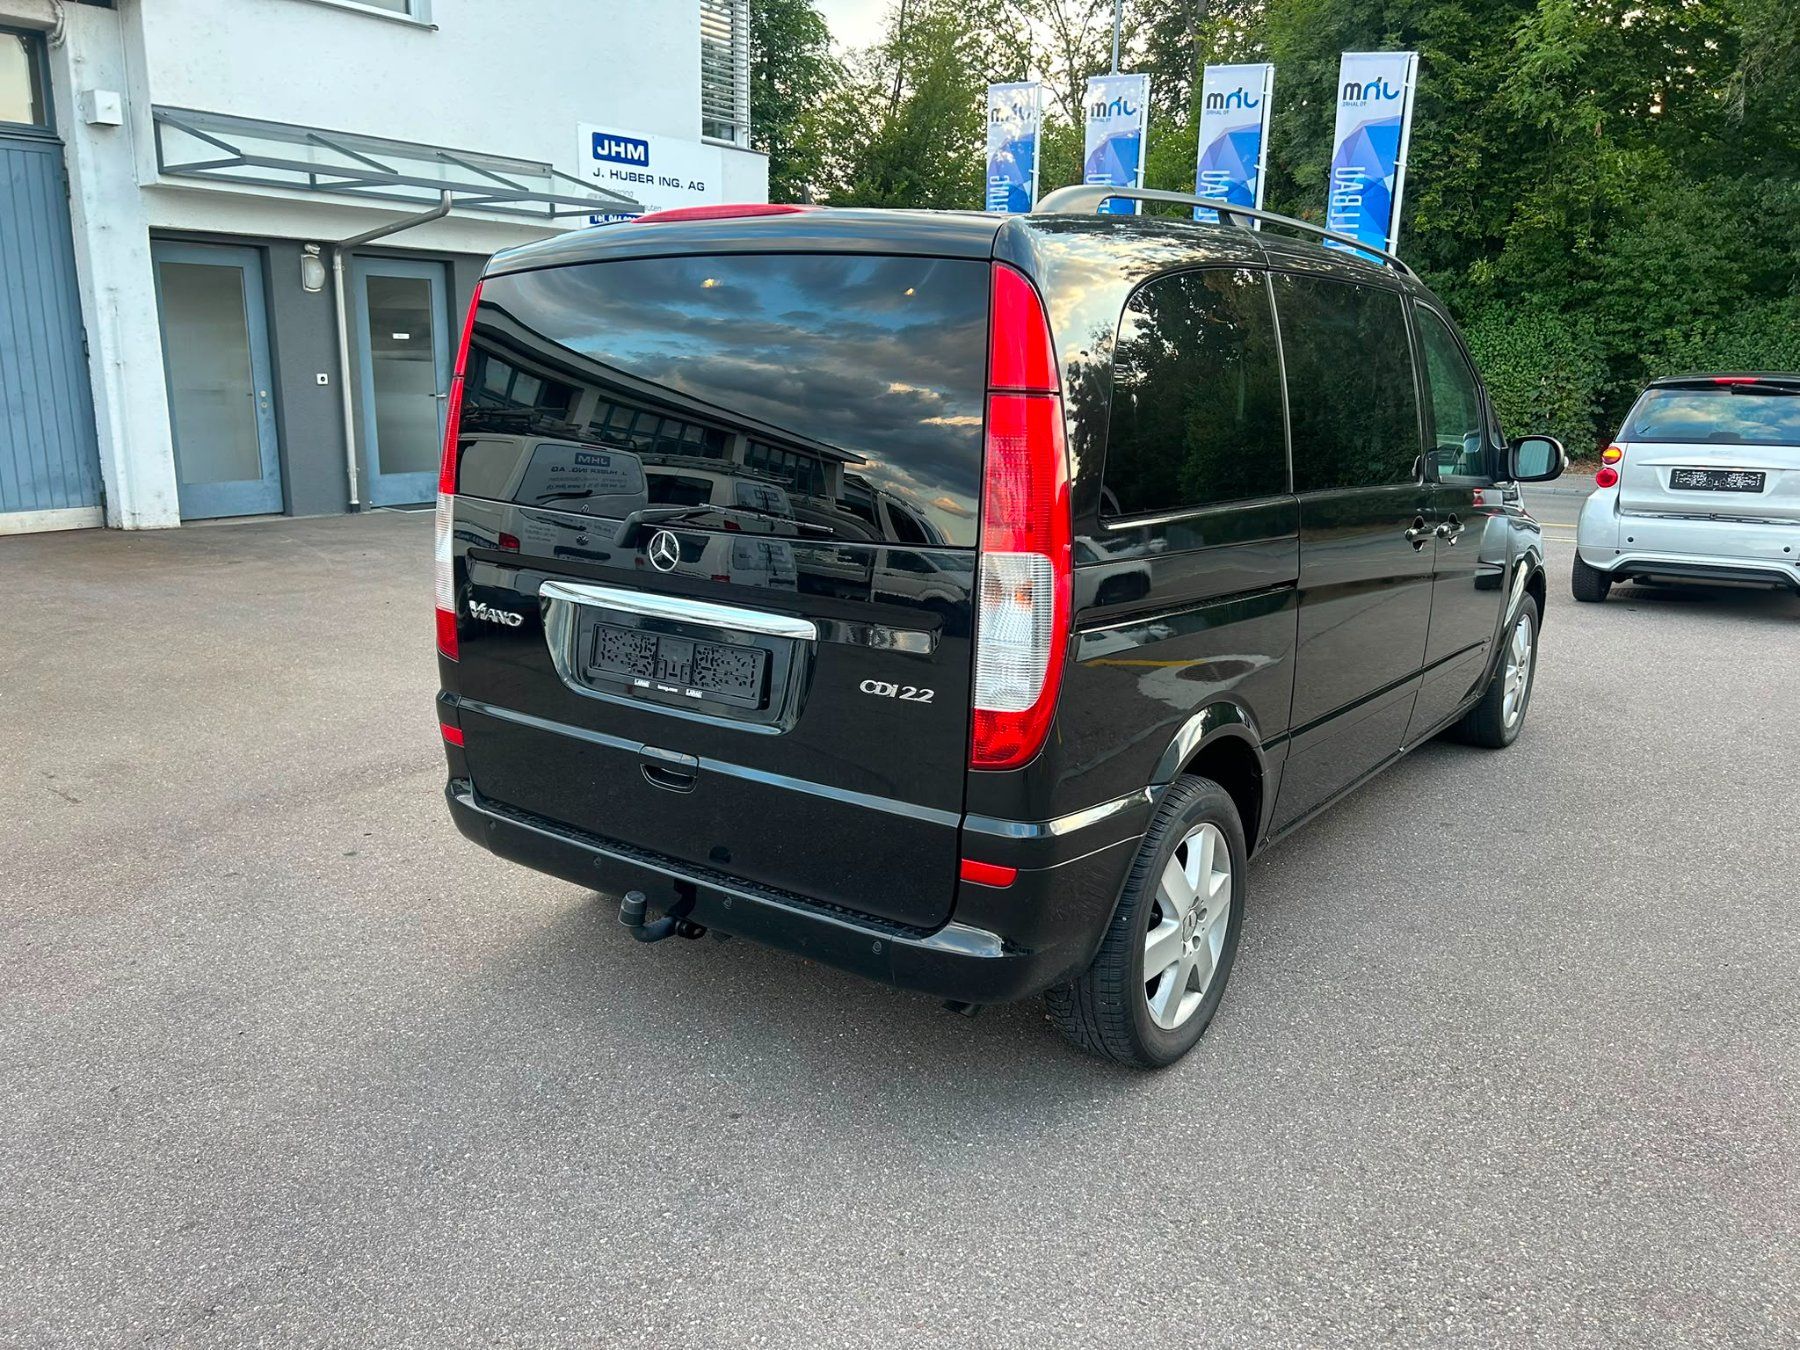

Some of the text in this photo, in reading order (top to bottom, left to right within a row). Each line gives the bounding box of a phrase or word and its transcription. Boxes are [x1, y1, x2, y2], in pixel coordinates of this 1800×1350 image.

[596, 139, 645, 162] JHM
[593, 167, 705, 192] J. HUBER ING. AG
[468, 600, 524, 627] VIANO
